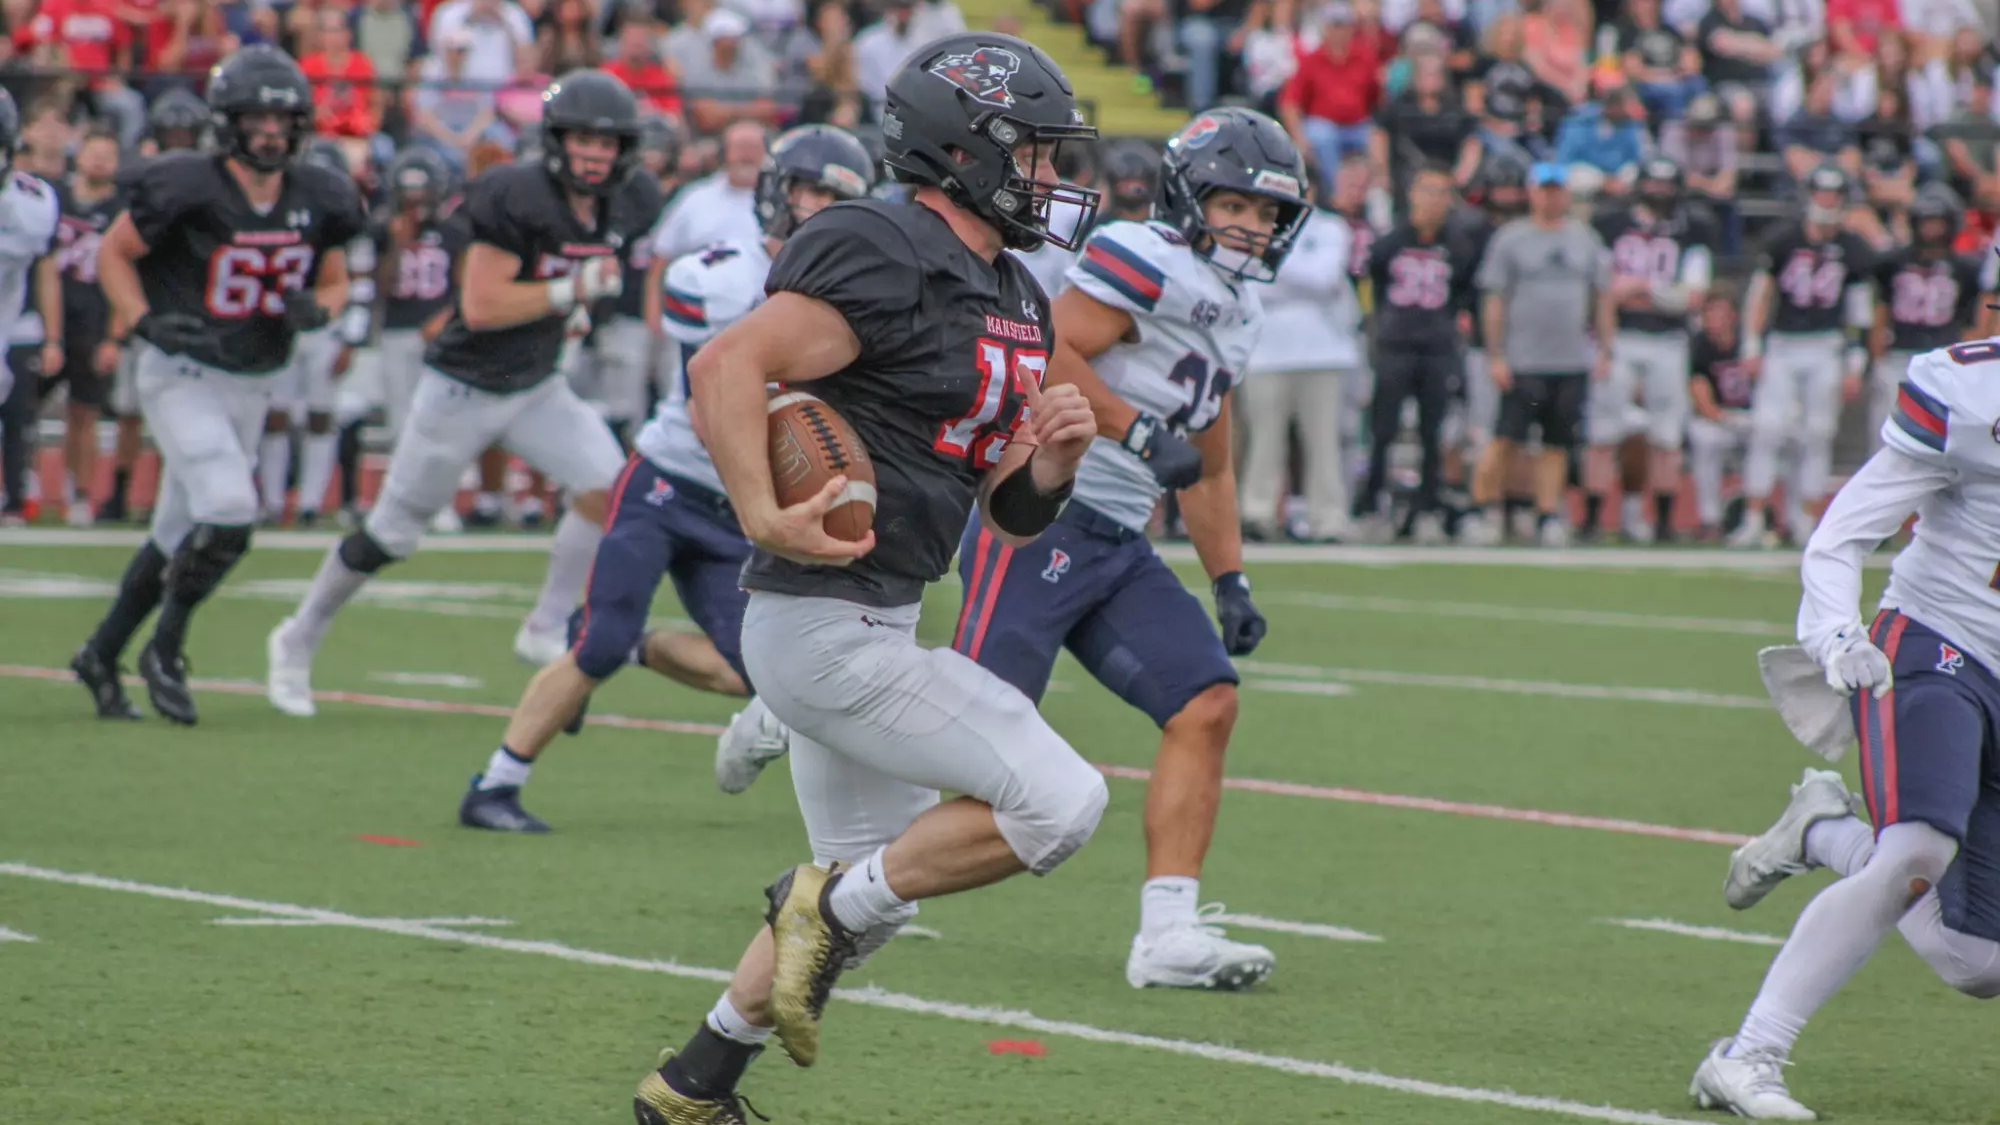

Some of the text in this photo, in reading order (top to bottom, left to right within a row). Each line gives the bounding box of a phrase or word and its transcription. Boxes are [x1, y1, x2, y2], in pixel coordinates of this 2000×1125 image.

[205, 244, 316, 318] 63
[986, 314, 1042, 343] MANSFIELD
[1040, 547, 1072, 585] P
